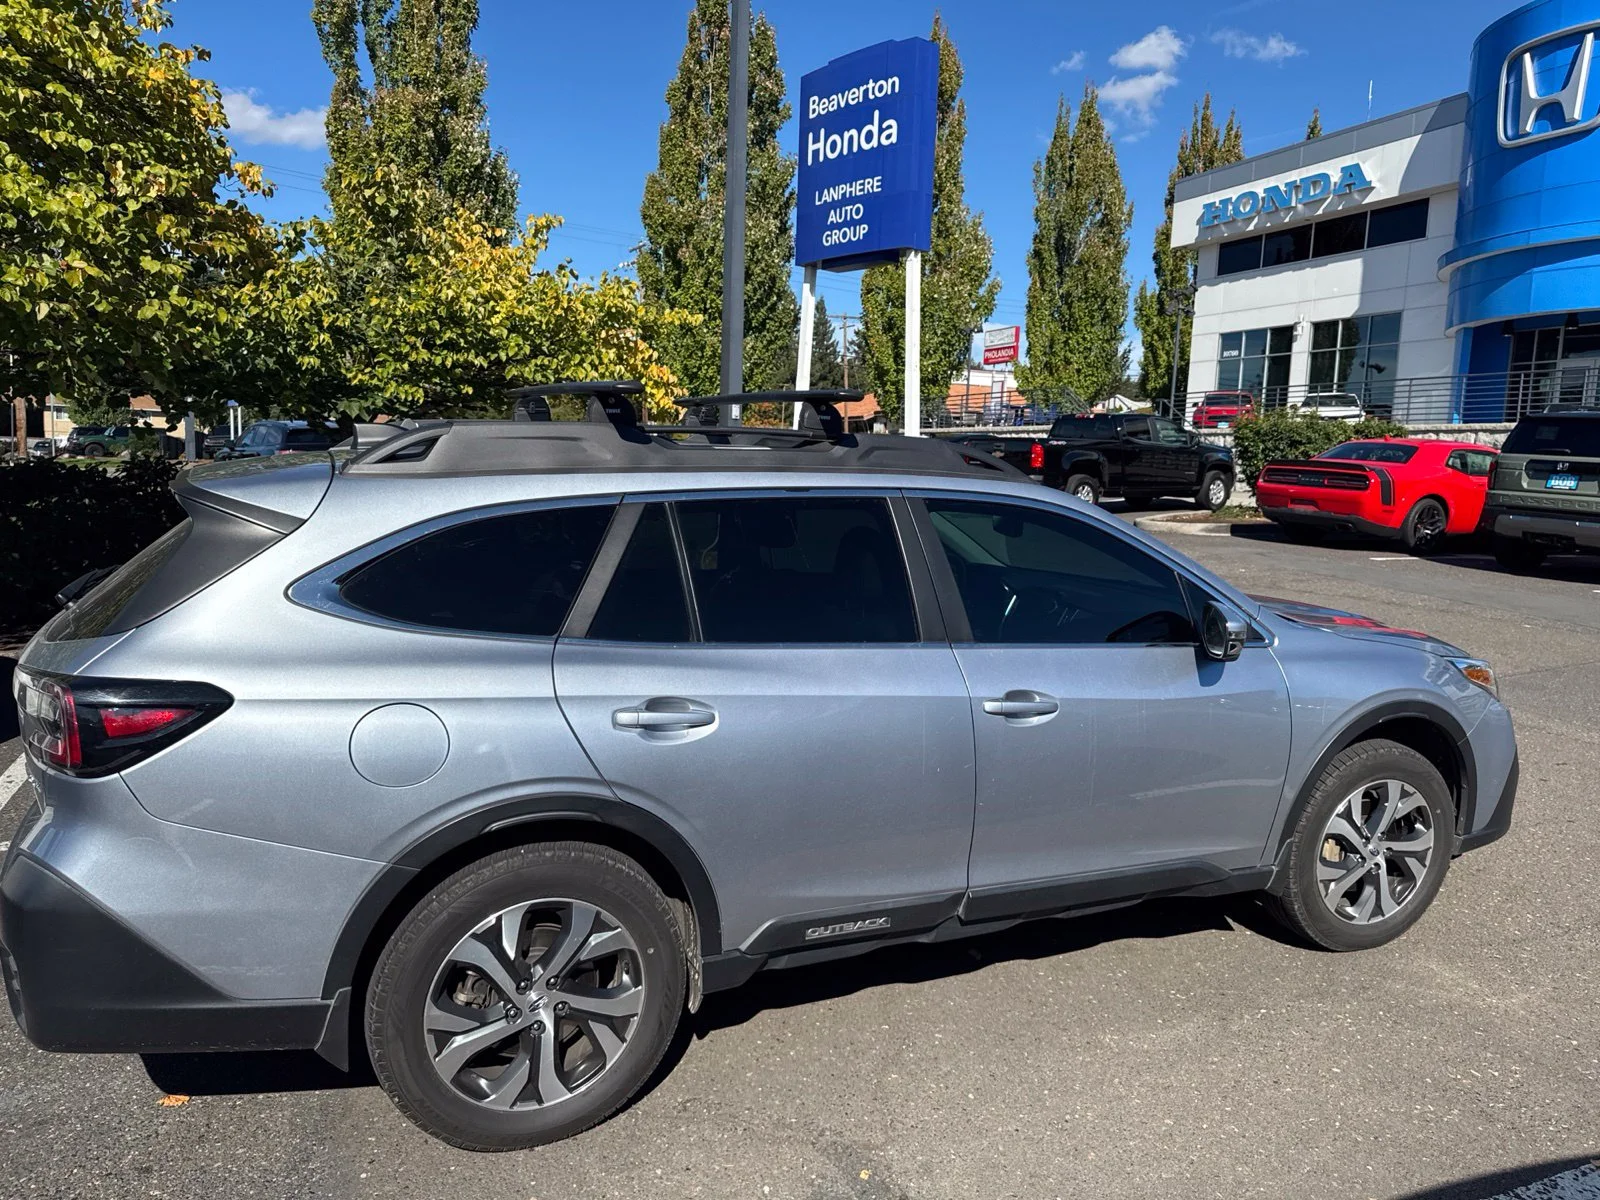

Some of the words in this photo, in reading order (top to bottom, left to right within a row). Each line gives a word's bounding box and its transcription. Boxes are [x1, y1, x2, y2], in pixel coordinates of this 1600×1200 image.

[808, 76, 900, 119] Beaverton
[807, 109, 898, 166] Honda
[815, 176, 882, 205] LANPHERE
[1200, 162, 1372, 228] HONDA
[827, 203, 864, 225] AUTO
[822, 224, 869, 246] GROUP
[807, 916, 888, 936] OUTBACK
